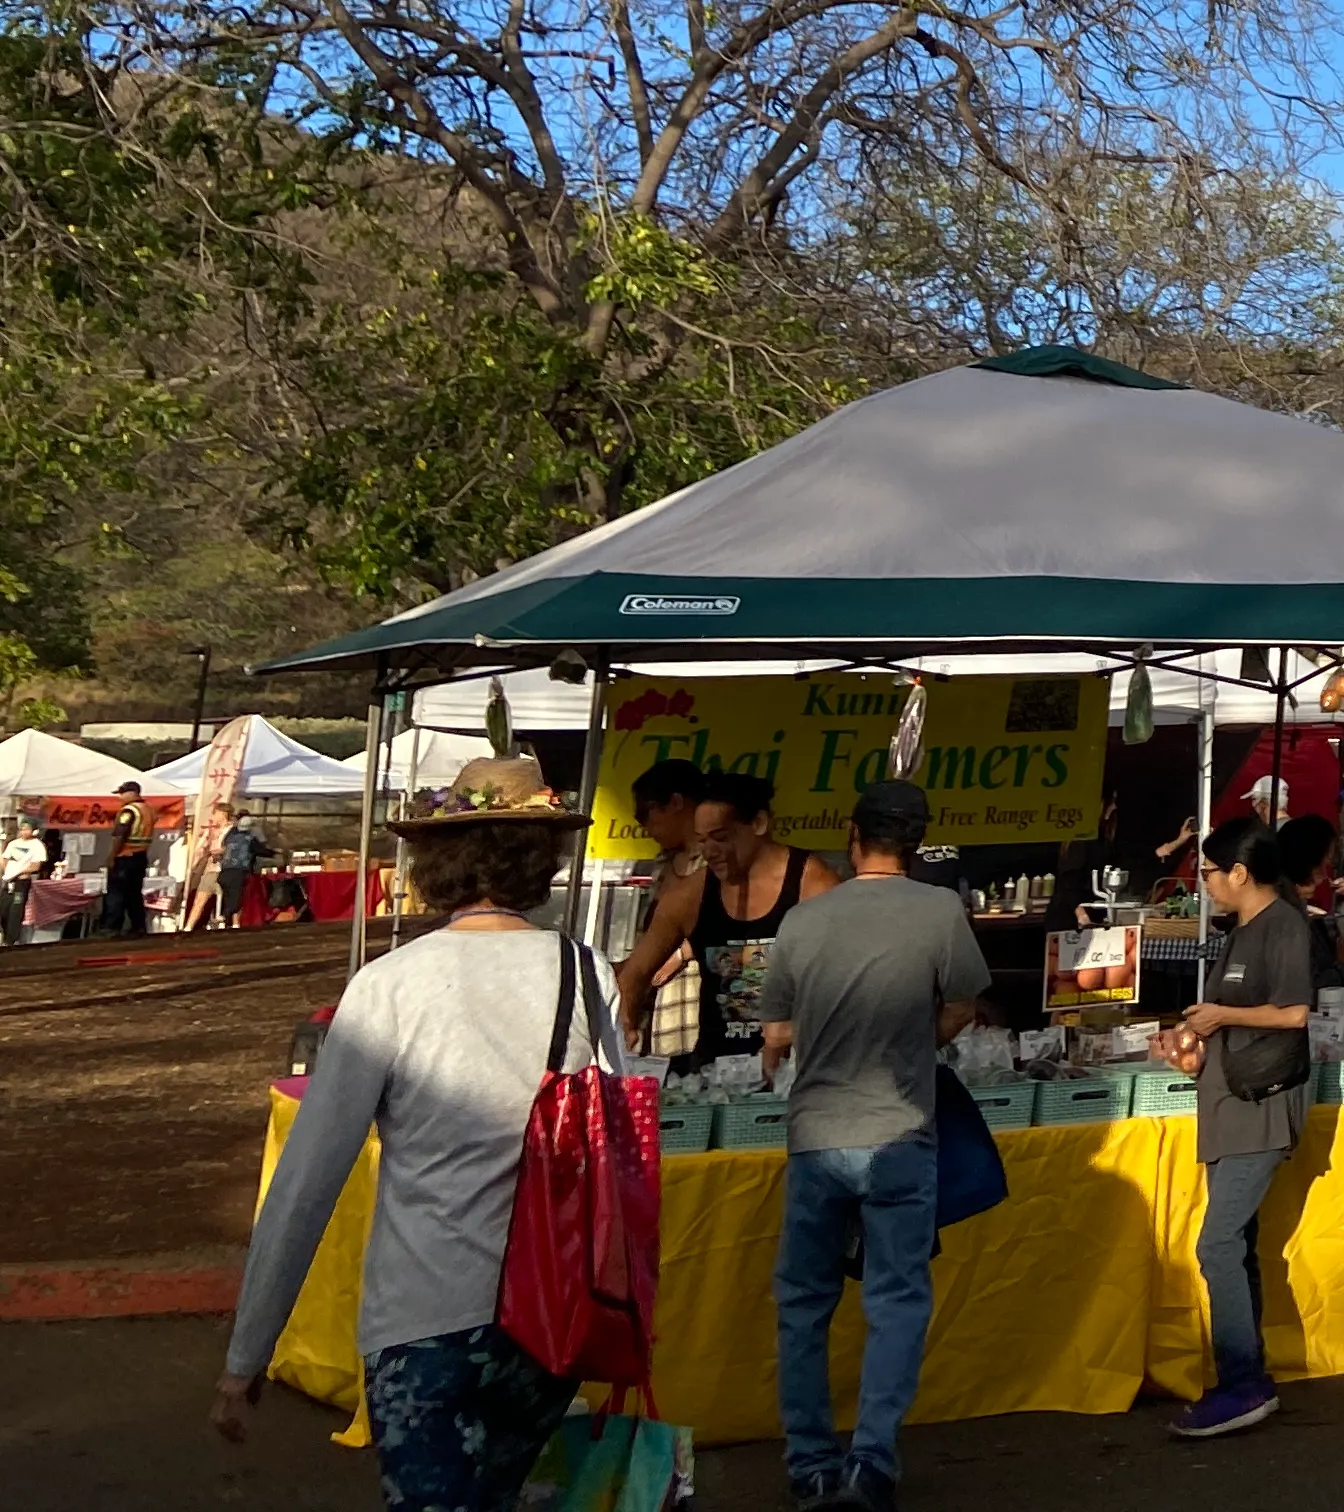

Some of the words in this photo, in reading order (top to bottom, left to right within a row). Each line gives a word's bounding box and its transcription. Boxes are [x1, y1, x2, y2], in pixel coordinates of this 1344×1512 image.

[630, 597, 714, 610] Coleman
[800, 683, 905, 716] Kuni
[808, 729, 1070, 794] Famers
[607, 818, 655, 840] Loca
[770, 808, 852, 836] egetable
[938, 806, 978, 826] Free
[984, 805, 1040, 830] Range
[1045, 803, 1084, 829] Eggs
